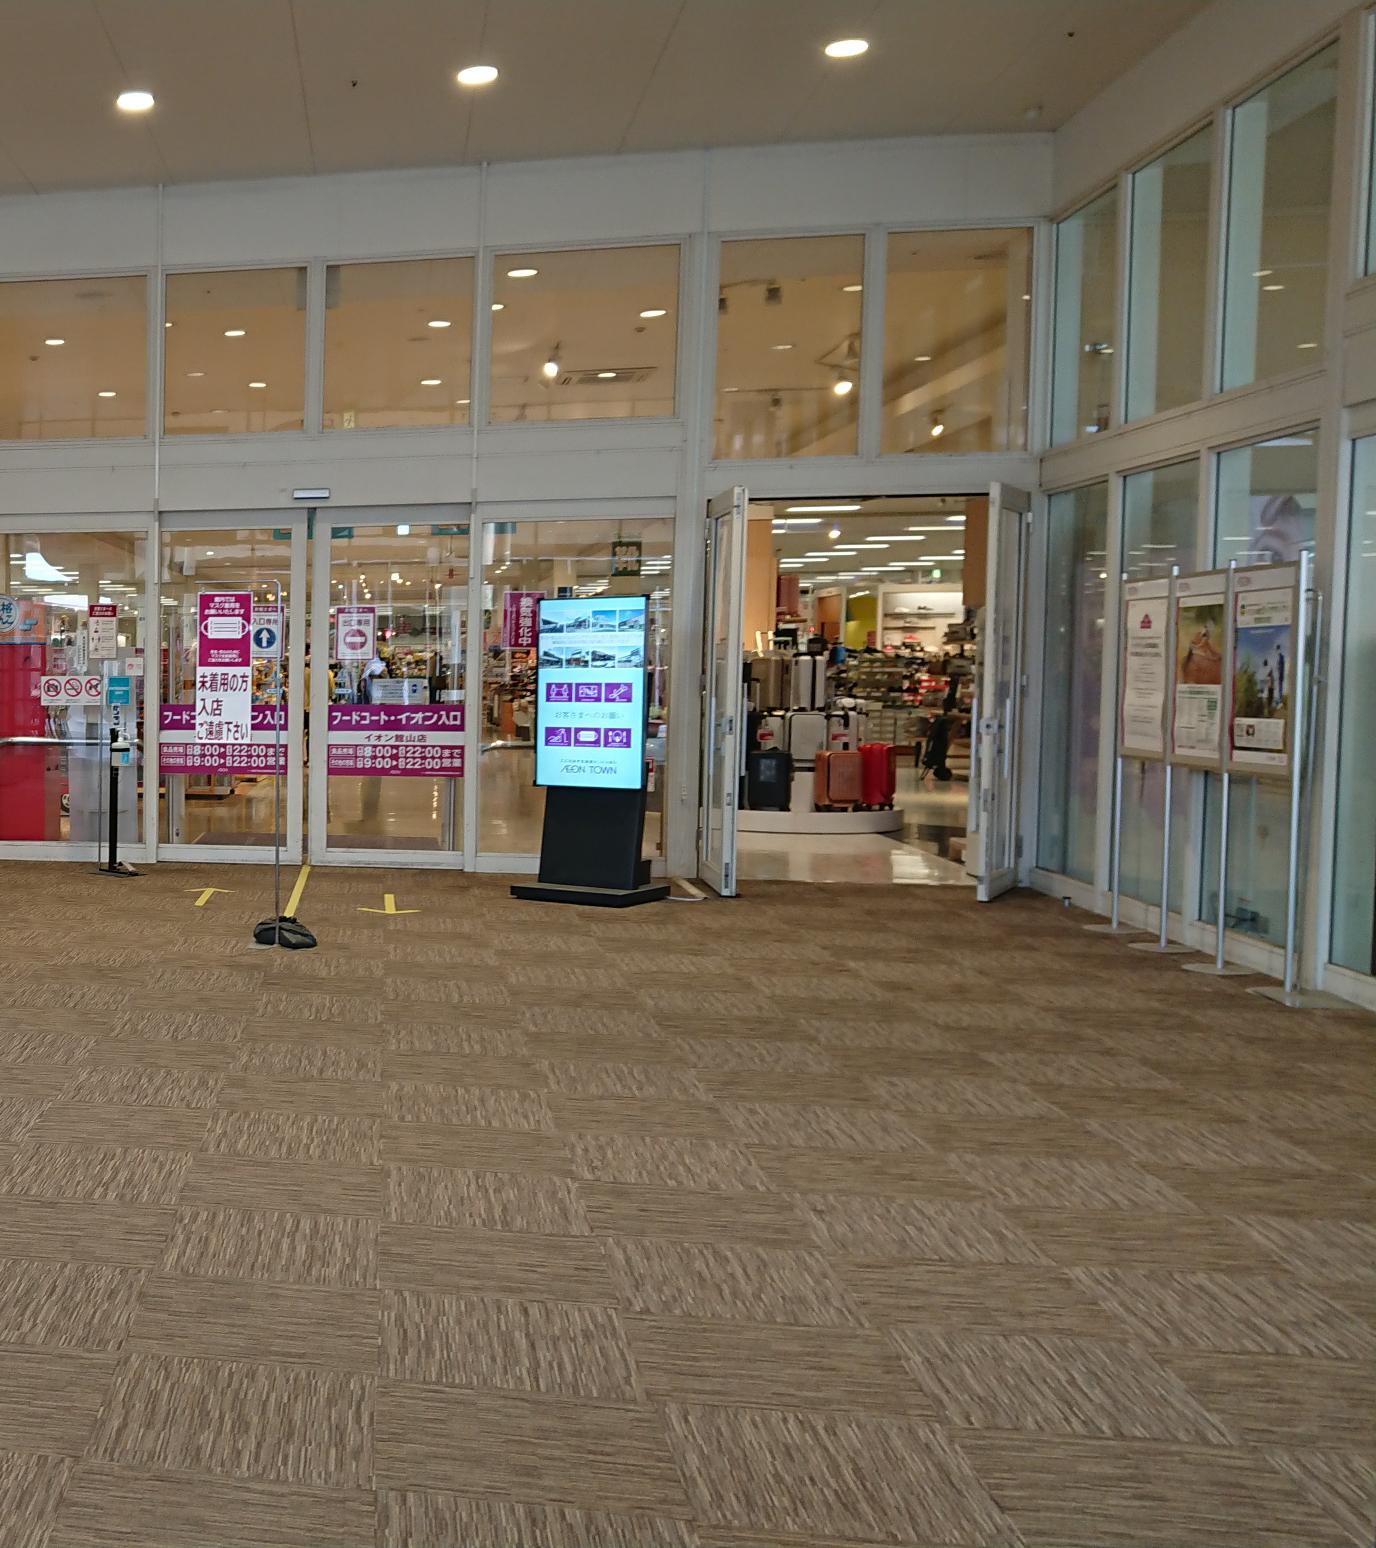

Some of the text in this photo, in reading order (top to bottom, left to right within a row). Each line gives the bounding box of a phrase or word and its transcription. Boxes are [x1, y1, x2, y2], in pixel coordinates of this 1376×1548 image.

[199, 672, 249, 692] 未着用の方
[198, 699, 224, 716] 入店
[332, 712, 461, 725] フードコート・イオン入口
[197, 721, 249, 741] ご遠慮下さい
[589, 766, 617, 775] TOWN
